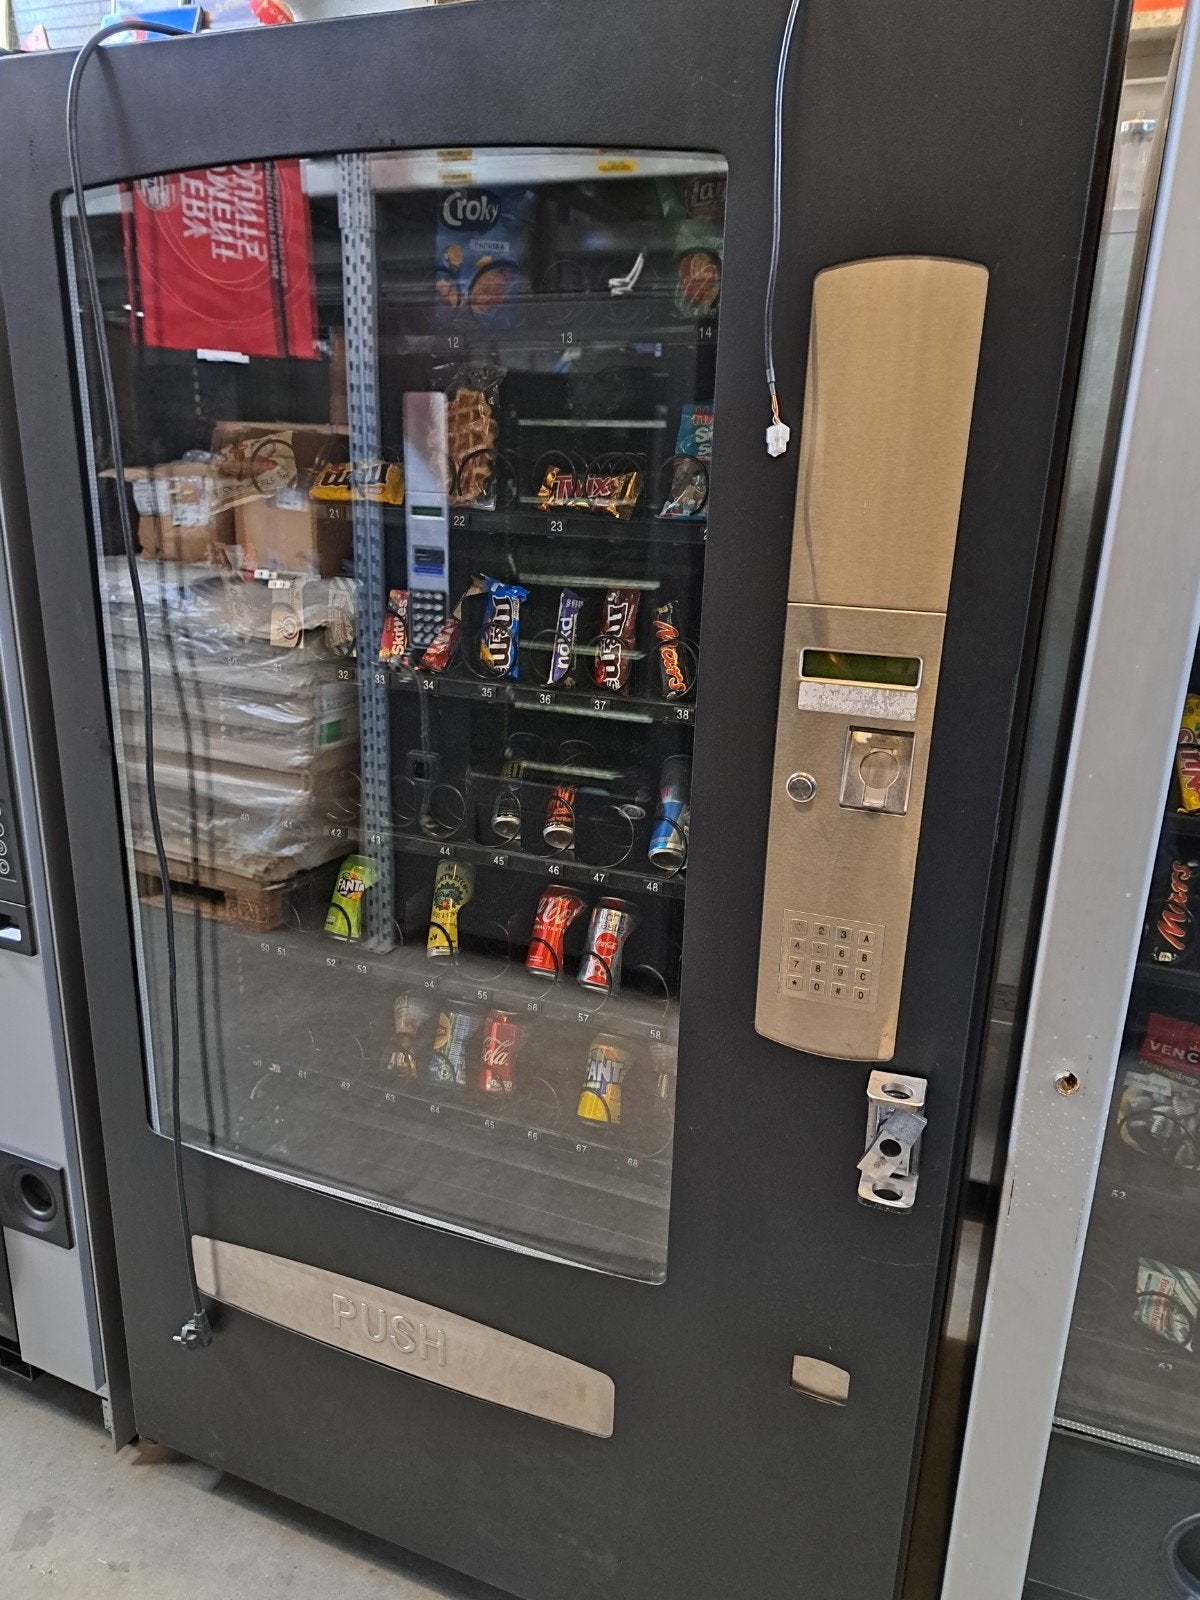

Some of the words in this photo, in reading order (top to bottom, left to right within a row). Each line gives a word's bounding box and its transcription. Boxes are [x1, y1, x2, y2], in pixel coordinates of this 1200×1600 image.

[442, 190, 499, 227] Croky
[699, 327, 712, 338] 14
[447, 336, 460, 349] 12
[560, 332, 573, 344] 13
[329, 508, 340, 519] 21
[453, 515, 466, 527] 22
[550, 520, 563, 532] 23
[338, 669, 349, 679] 32
[374, 674, 385, 685] 33
[423, 680, 435, 690] 34
[481, 687, 493, 698] 35
[539, 694, 551, 704] 36
[594, 700, 606, 710] 37
[676, 709, 689, 720] 38
[330, 828, 342, 838] 42
[370, 834, 382, 845] 43
[439, 846, 451, 856] 44
[493, 856, 505, 866] 45
[548, 865, 560, 876] 46
[593, 873, 606, 883] 47
[646, 882, 659, 892] 48
[840, 930, 847, 939] 3
[863, 935, 870, 943] A
[794, 941, 800, 949] 4
[838, 949, 845, 958] 6
[861, 953, 868, 962] B
[326, 957, 336, 967] 52
[793, 960, 799, 968] 7
[357, 964, 367, 974] 53
[815, 964, 821, 973] 8
[837, 968, 844, 976] 9
[860, 972, 866, 981] C
[477, 990, 488, 1000] 55
[858, 991, 864, 1000] D
[527, 1002, 538, 1012] 56
[577, 1012, 589, 1023] 57
[650, 1029, 661, 1040] 58
[385, 1092, 395, 1103] 63
[430, 1104, 440, 1114] 64
[527, 1130, 538, 1141] 66
[576, 1143, 587, 1153] 67
[627, 1157, 638, 1168] 68
[331, 1292, 448, 1367] PUSH
